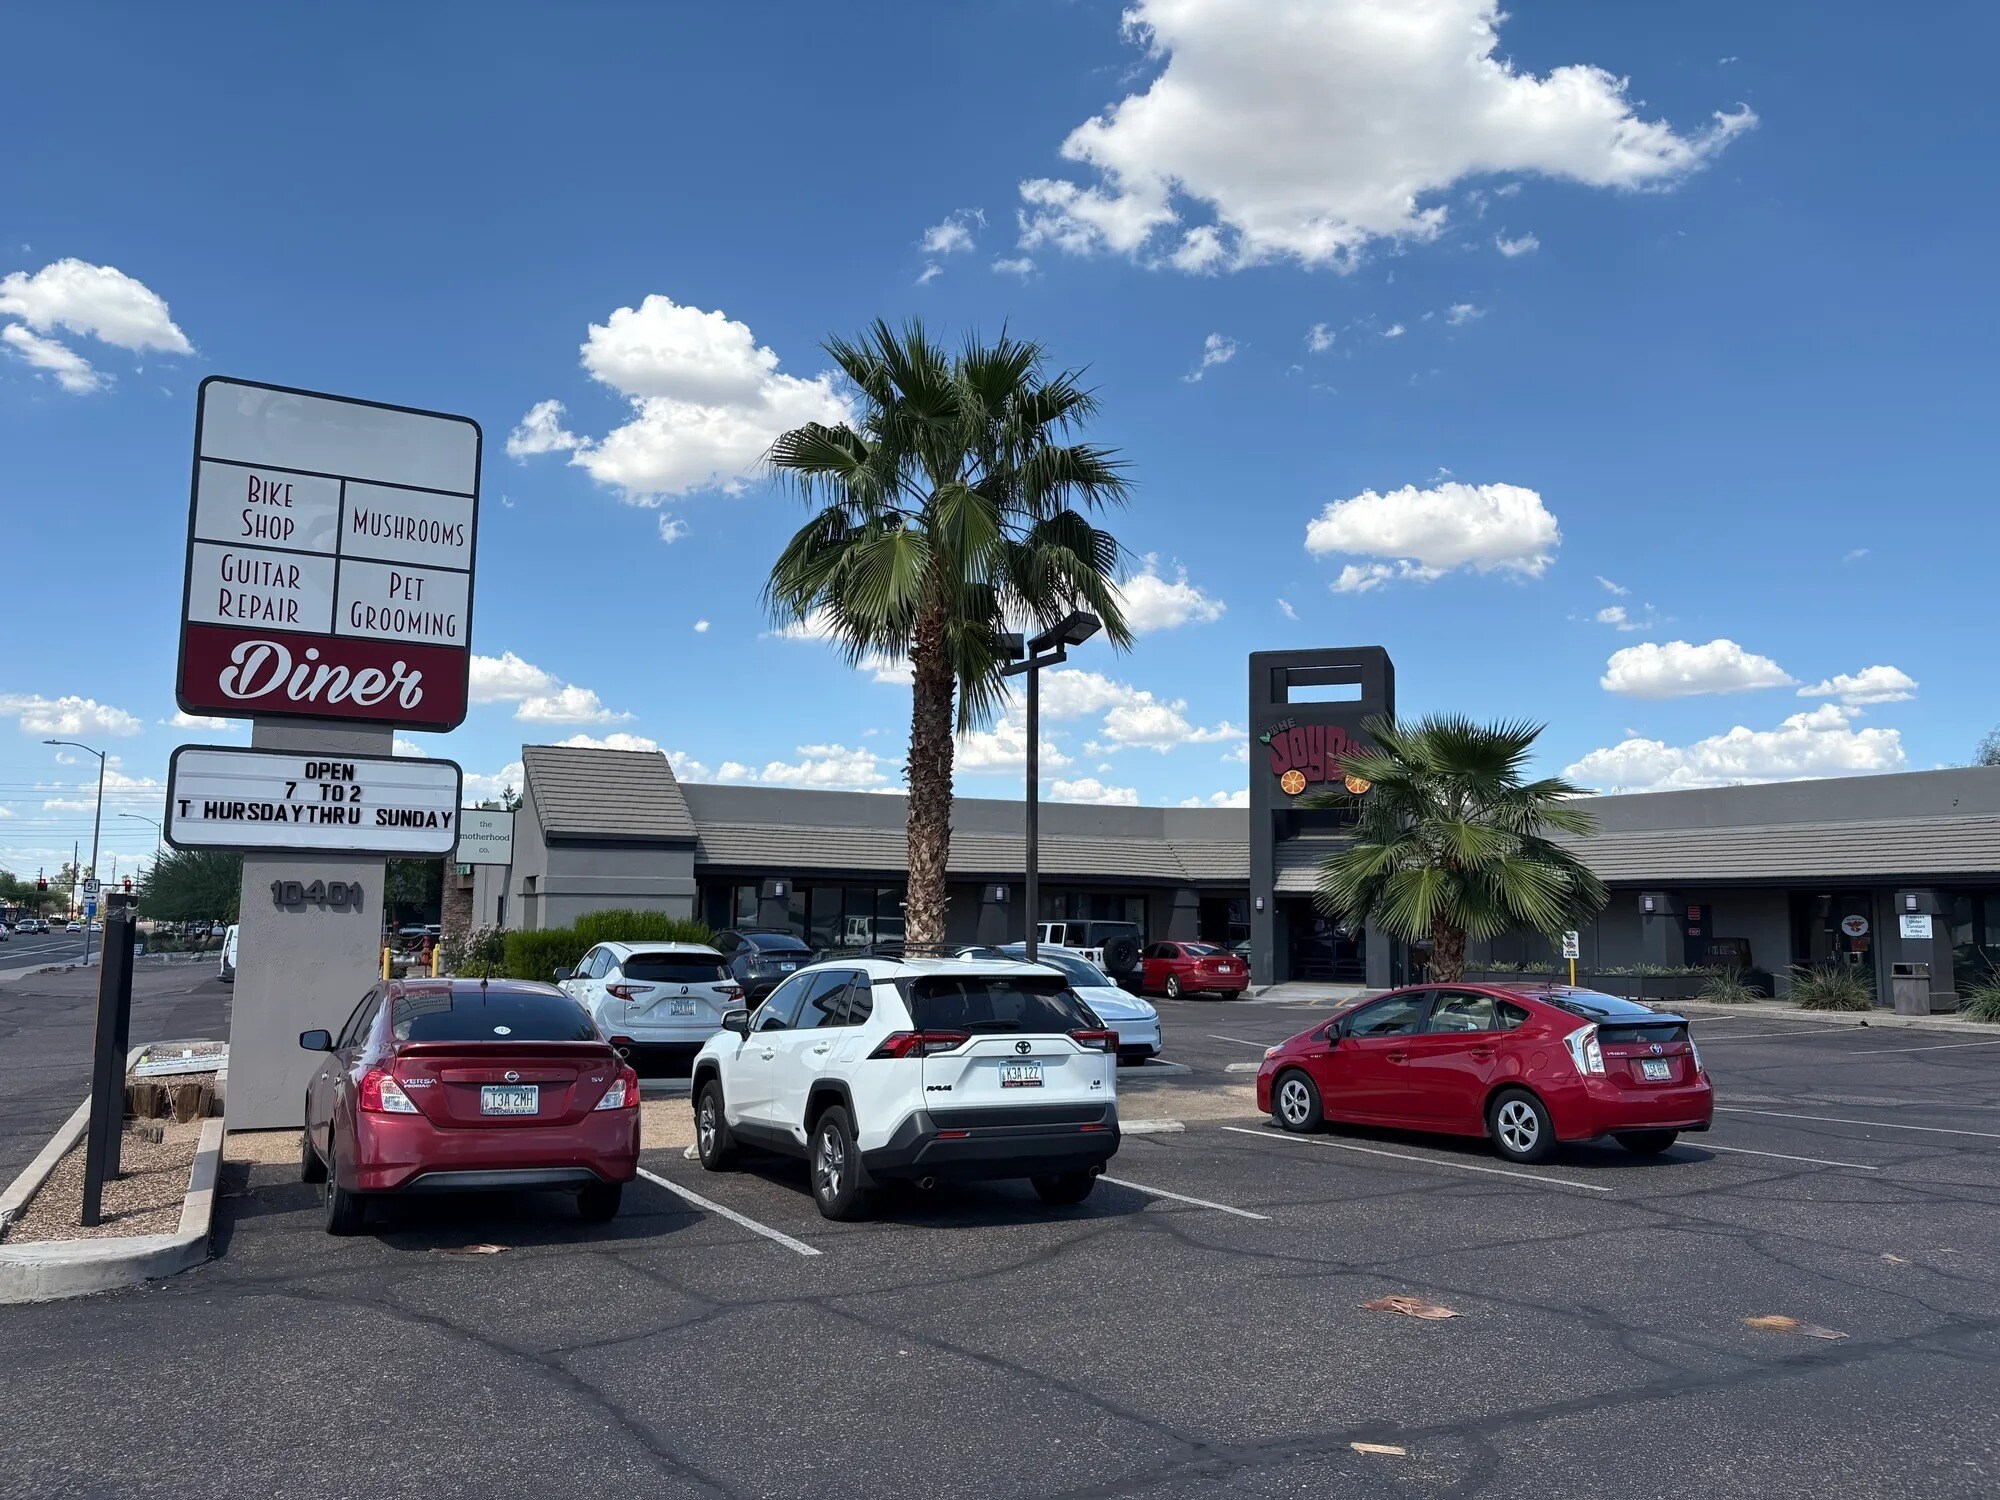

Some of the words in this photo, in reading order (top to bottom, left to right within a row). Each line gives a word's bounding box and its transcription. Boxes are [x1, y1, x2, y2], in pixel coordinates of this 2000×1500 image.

[247, 474, 293, 508] BIKE
[241, 508, 295, 542] SHOP
[353, 506, 464, 547] MUSHROOMS
[220, 553, 301, 590] GUITAR
[389, 571, 424, 602] PET
[218, 587, 300, 625] REPAIR
[351, 601, 456, 637] GROOMING
[218, 639, 423, 709] Diner
[304, 761, 355, 782] OPEN
[285, 782, 297, 800] 7
[319, 783, 344, 802] TO
[349, 785, 361, 803] 2
[375, 808, 453, 829] SUNDAY
[87, 882, 97, 891] 51
[272, 880, 362, 906] 10401
[491, 1092, 510, 1107] T3A
[513, 1092, 533, 1107] 2MH
